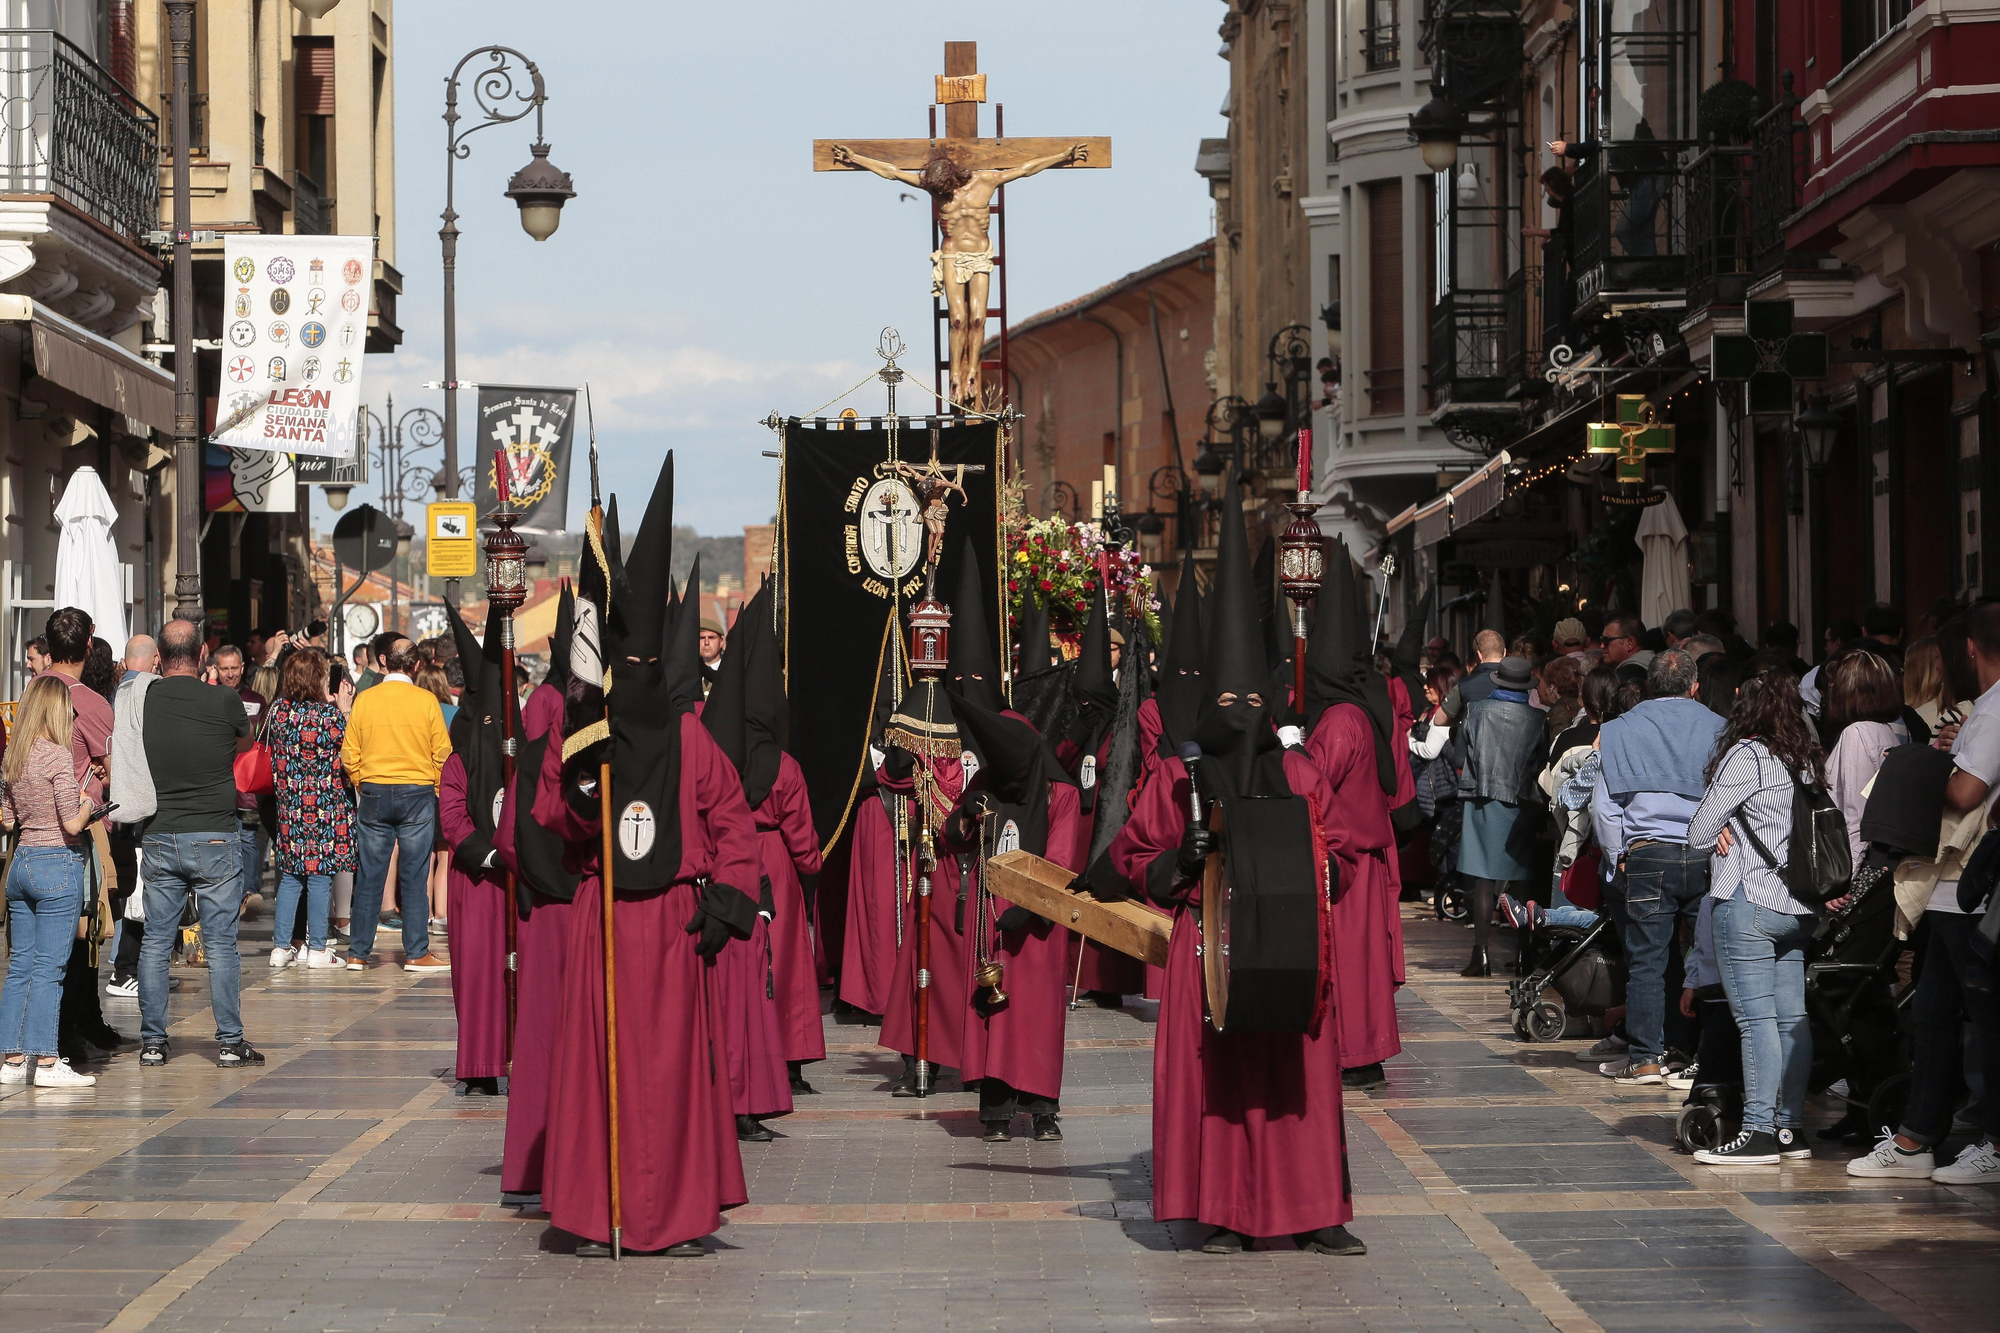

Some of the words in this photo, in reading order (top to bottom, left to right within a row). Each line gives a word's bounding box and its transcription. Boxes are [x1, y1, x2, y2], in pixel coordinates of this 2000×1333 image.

[267, 384, 331, 409] LEÓN
[266, 405, 312, 418] CIUDAD
[313, 408, 329, 419] DE
[483, 400, 512, 418] Semana
[513, 396, 538, 408] Santa
[539, 399, 549, 409] de
[548, 402, 568, 419] León
[264, 414, 327, 430] SEMANA
[263, 425, 326, 443] SANTA
[844, 476, 869, 514] SANTO
[1601, 495, 1635, 505] FUNDADA
[861, 577, 890, 600] LEÓN
[902, 575, 924, 599] 1992
